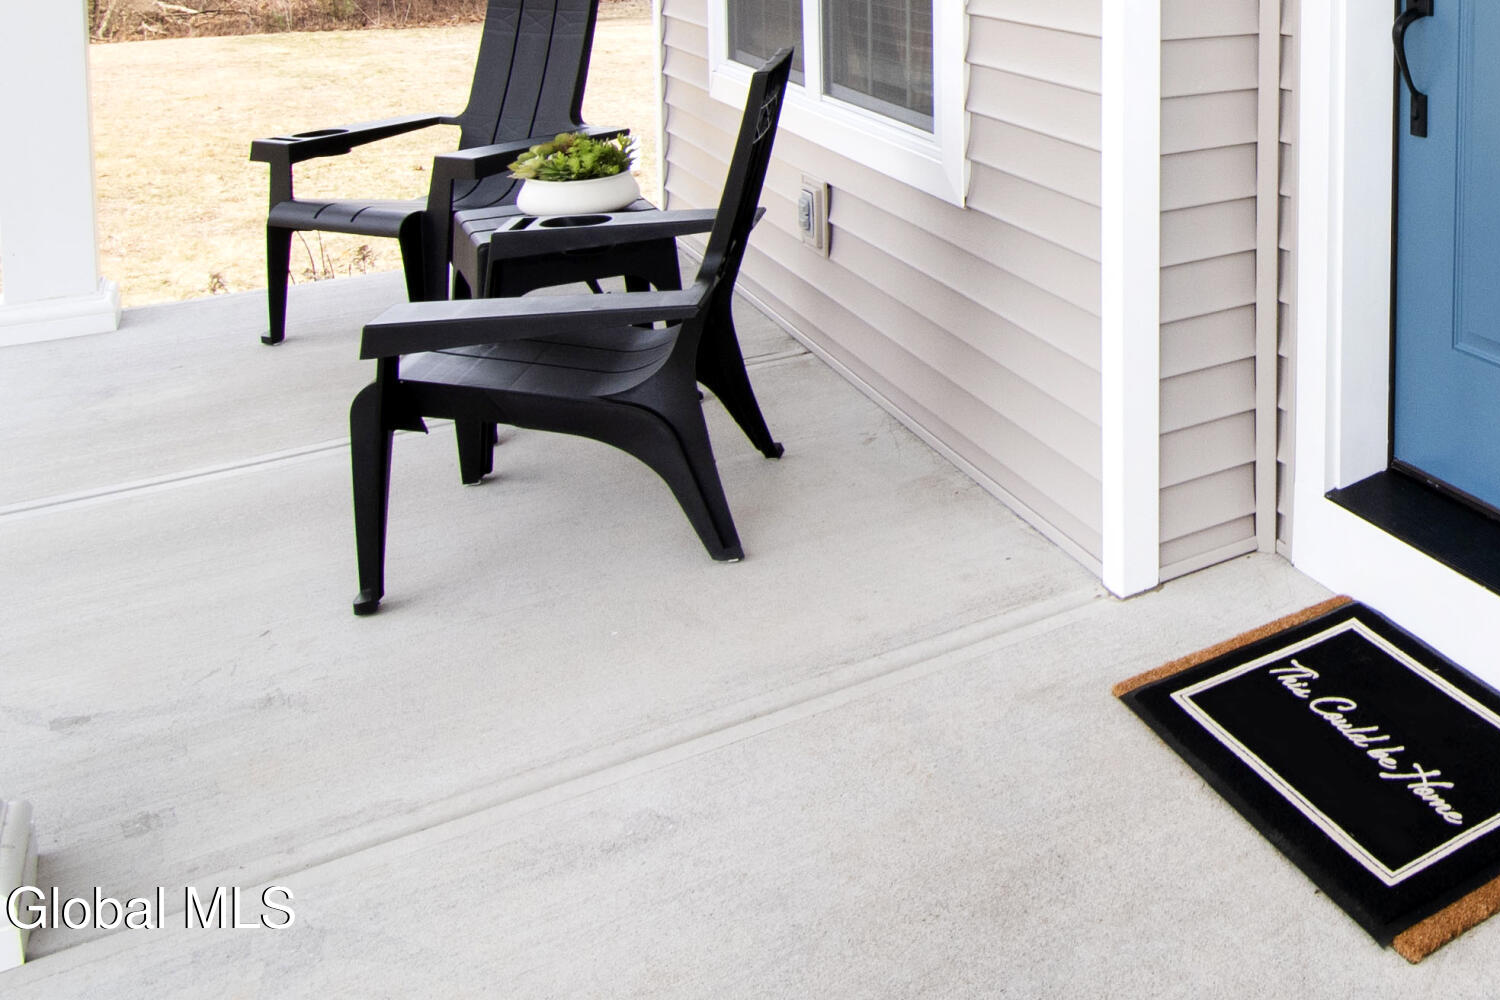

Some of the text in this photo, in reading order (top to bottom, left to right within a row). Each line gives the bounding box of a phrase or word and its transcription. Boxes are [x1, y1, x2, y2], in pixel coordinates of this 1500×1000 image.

[1269, 659, 1463, 826] This Could be Home
